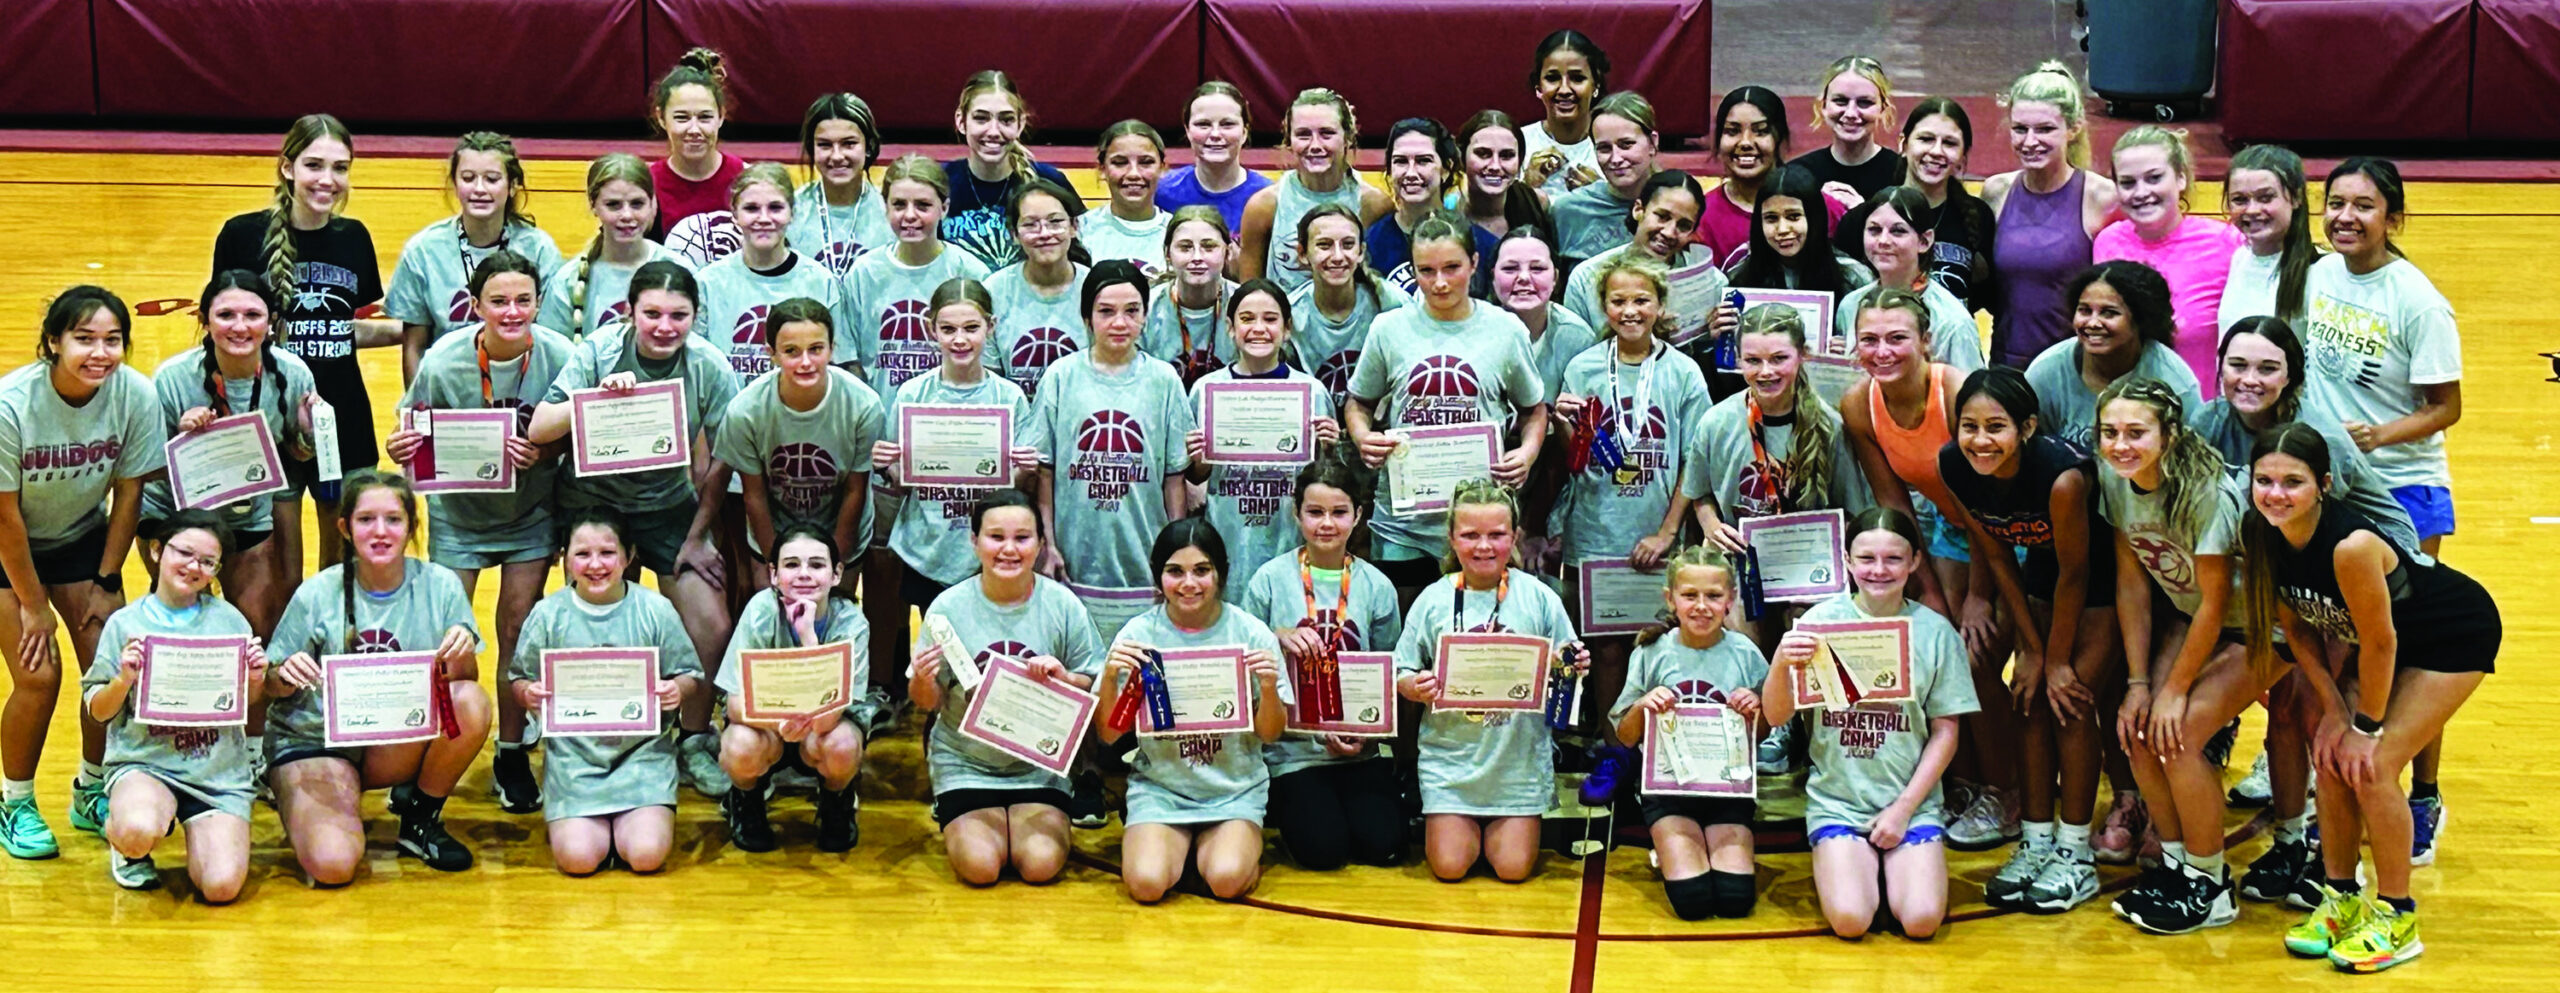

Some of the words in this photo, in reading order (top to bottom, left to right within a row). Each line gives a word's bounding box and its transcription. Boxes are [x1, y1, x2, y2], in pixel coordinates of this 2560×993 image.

[1069, 463, 1149, 483] BASKETBALL
[1088, 484, 1129, 500] CAMP
[1239, 498, 1280, 515] CAMP
[1822, 709, 1911, 732] BASKETBALL
[1840, 729, 1886, 749] CAMP
